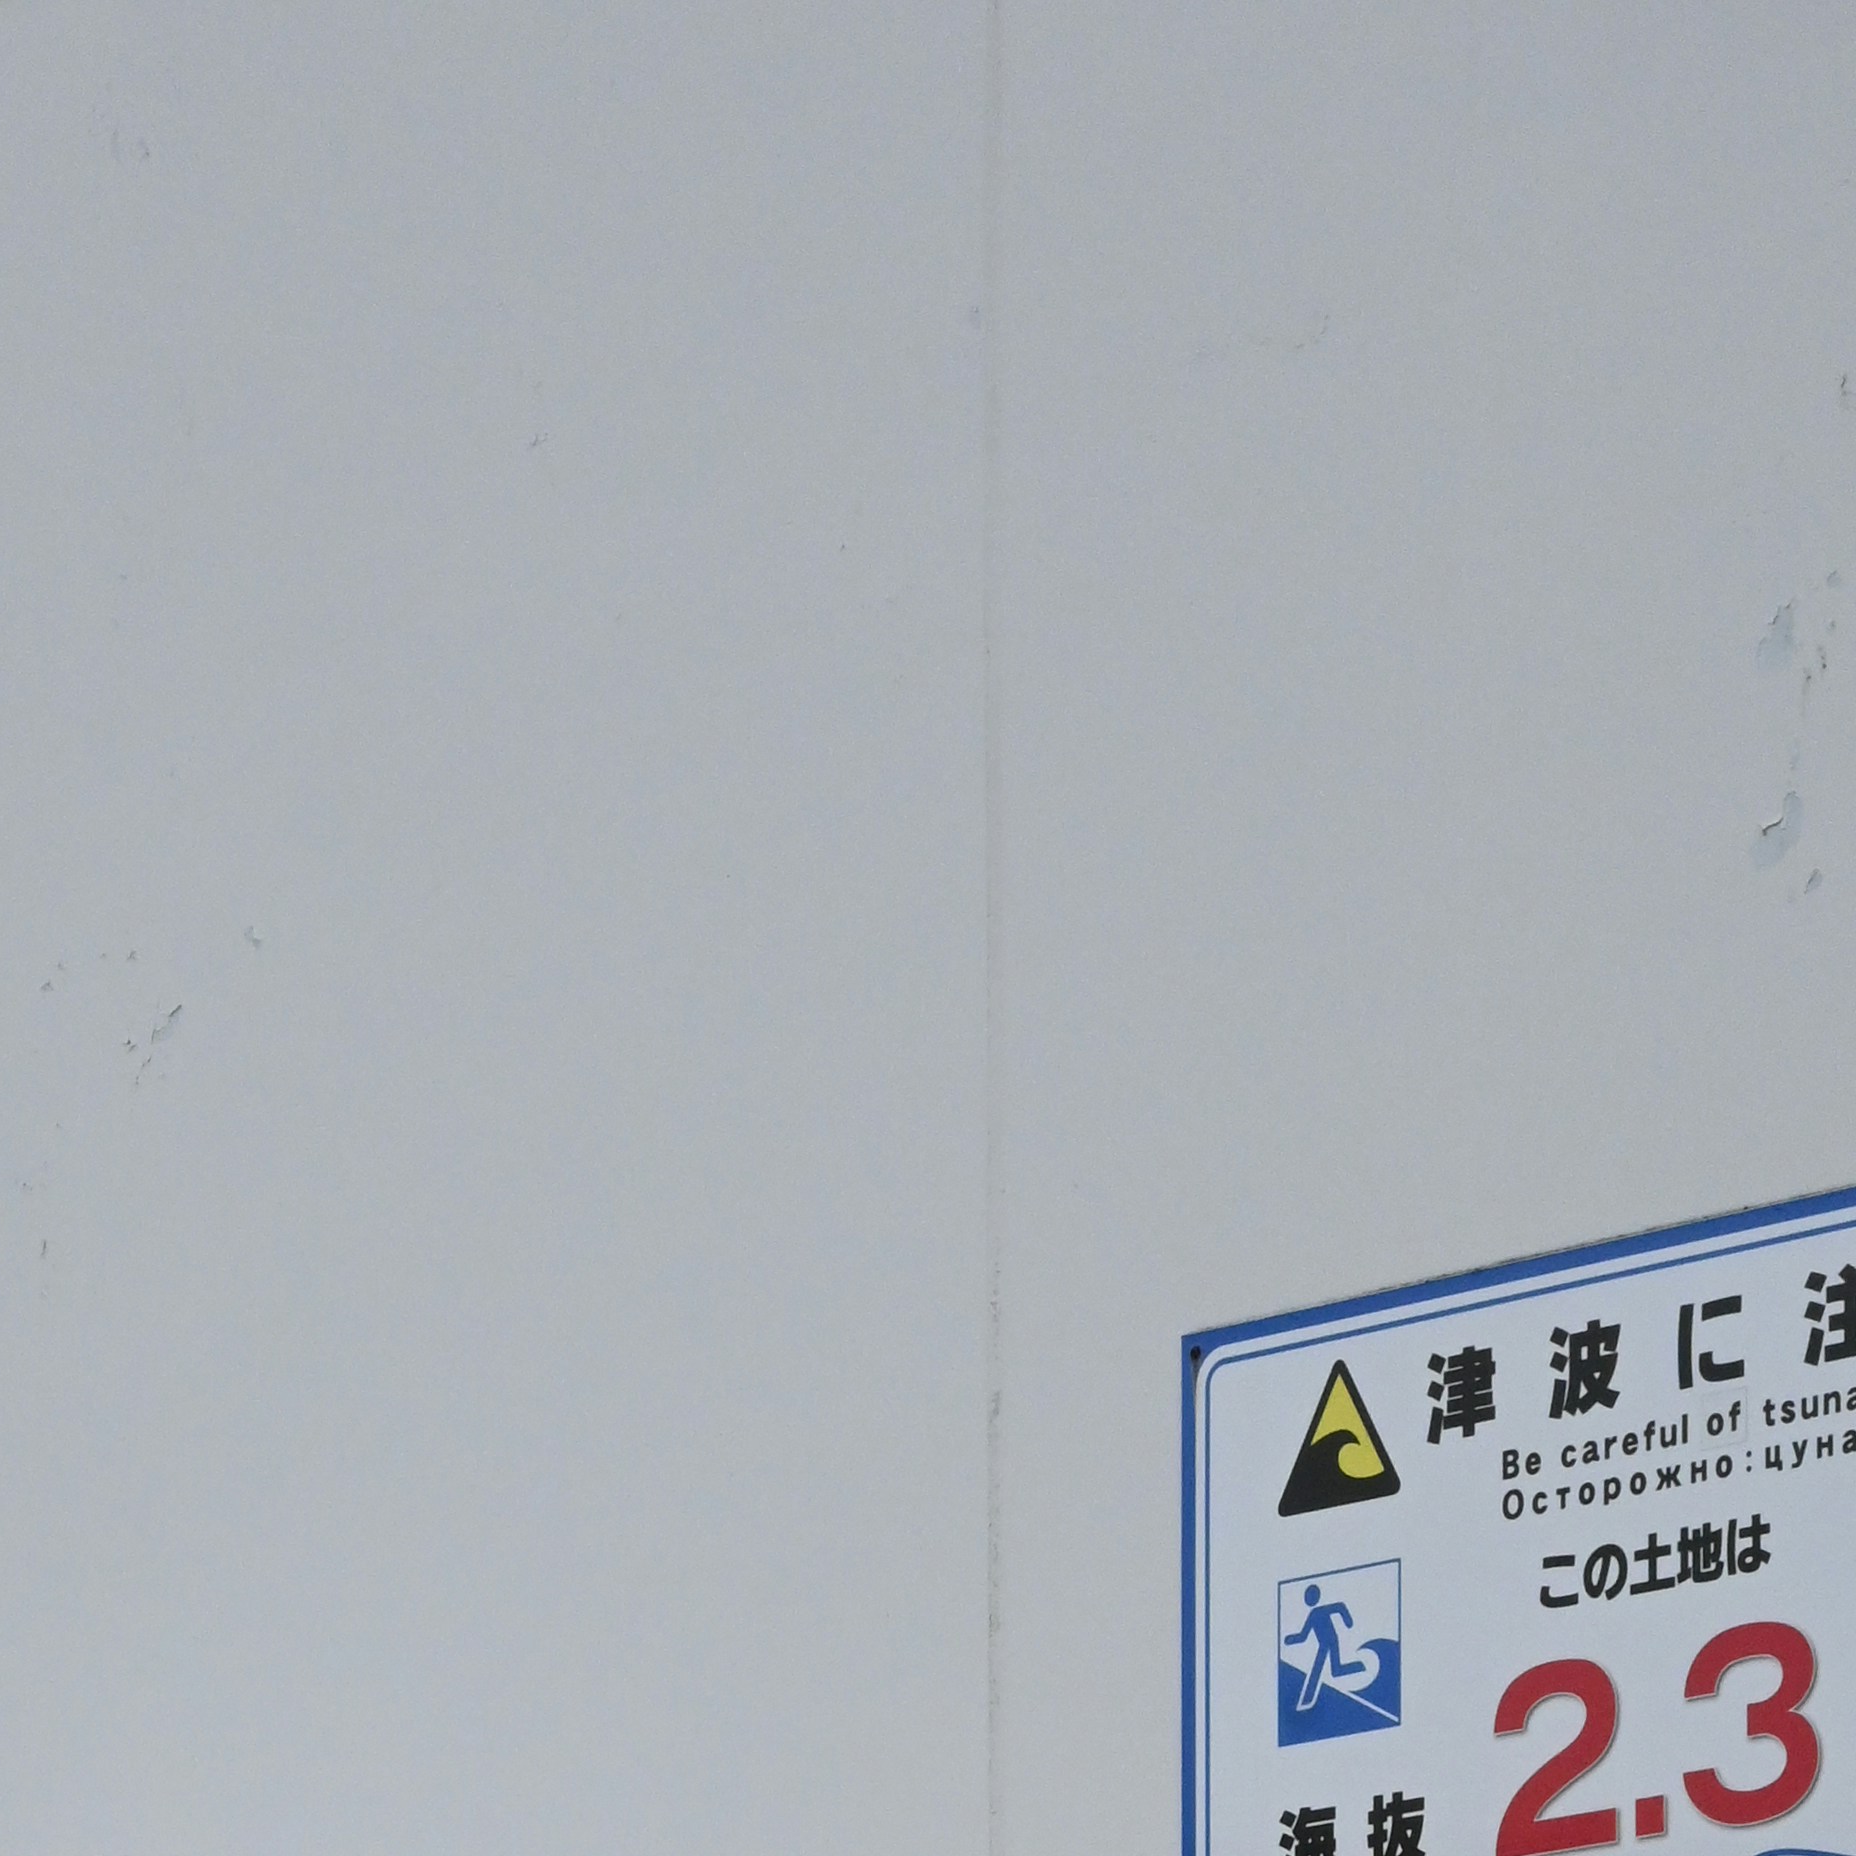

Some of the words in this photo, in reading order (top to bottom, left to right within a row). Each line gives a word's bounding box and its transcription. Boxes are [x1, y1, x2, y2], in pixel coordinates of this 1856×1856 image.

[1502, 1449, 1542, 1480] Be
[1560, 1414, 1689, 1468] careful
[1706, 1401, 1742, 1436] of
[1540, 1513, 1772, 1609] この土地は
